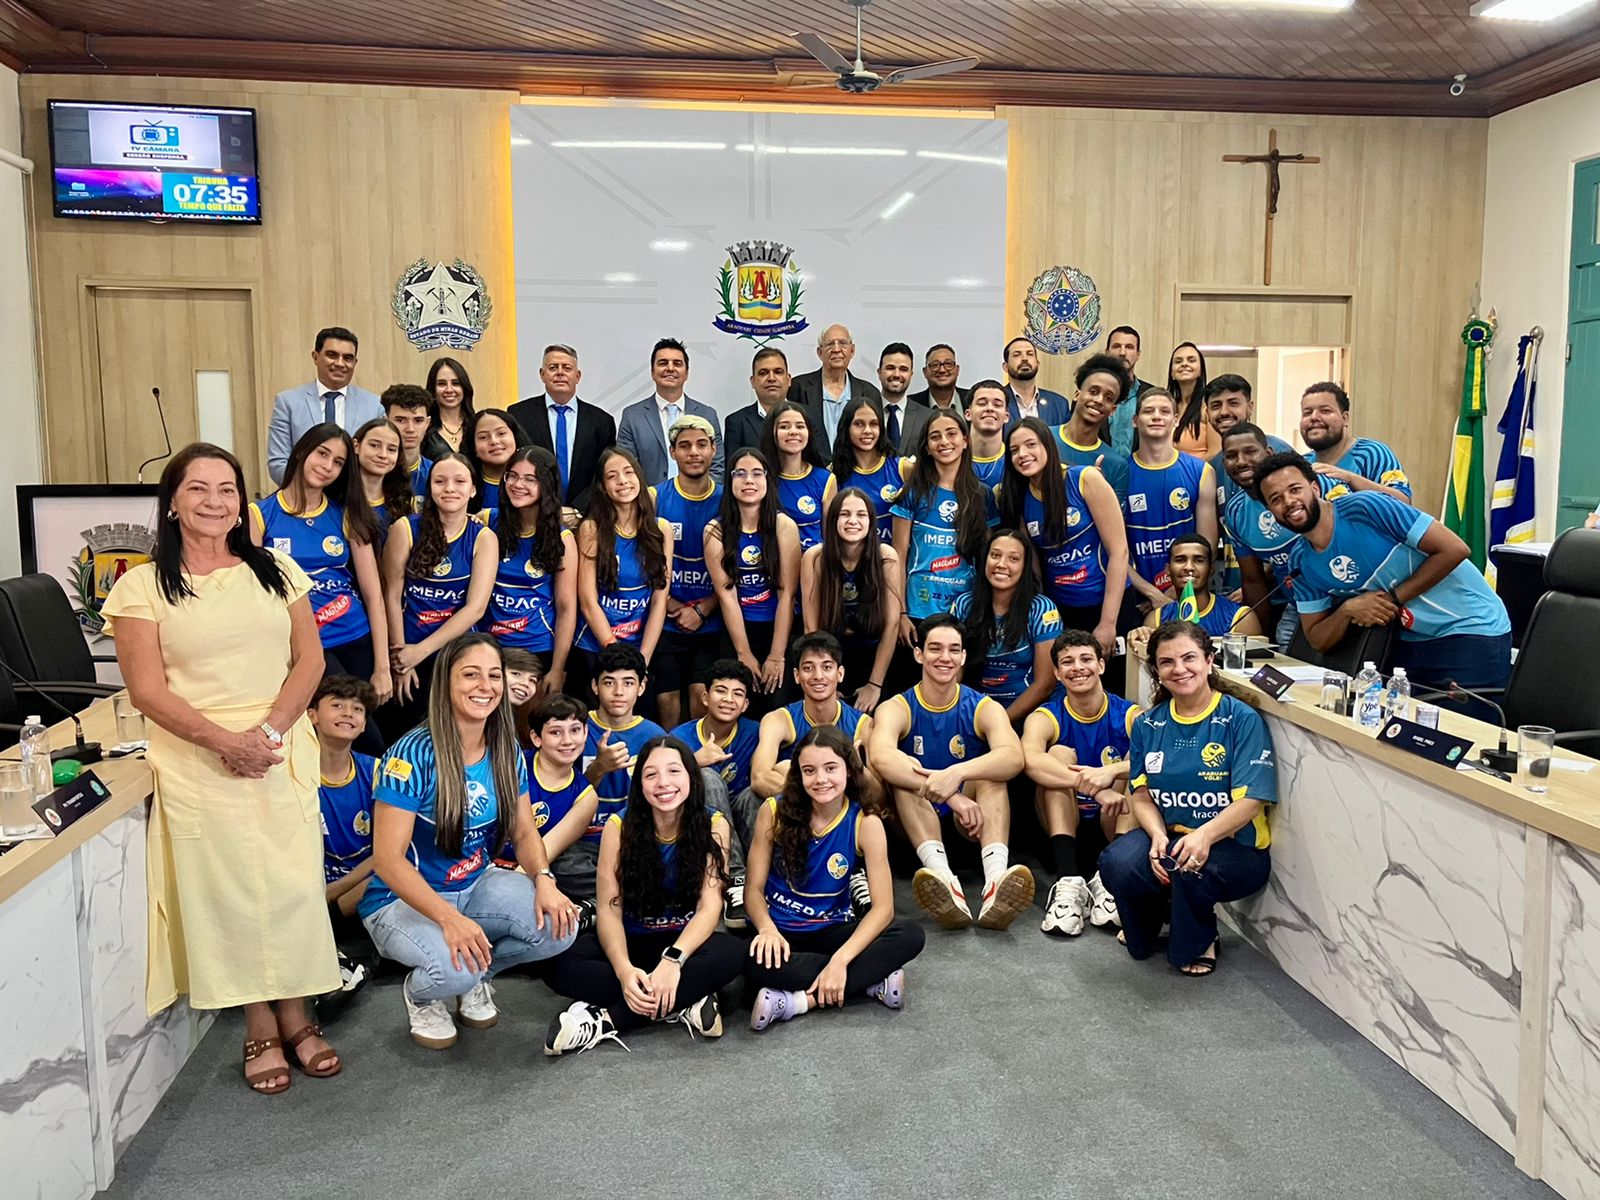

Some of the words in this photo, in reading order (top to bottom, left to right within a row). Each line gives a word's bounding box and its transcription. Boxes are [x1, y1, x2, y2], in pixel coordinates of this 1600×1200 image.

[192, 176, 229, 185] TRIBUNA
[173, 183, 248, 204] 07:35
[178, 202, 206, 210] TEMPO
[206, 203, 222, 211] QUE
[223, 203, 246, 212] FALTA
[409, 328, 431, 339] ESTADO
[458, 329, 479, 339] GERAIS
[924, 533, 956, 546] IMEP
[1135, 538, 1176, 555] IMEP
[932, 557, 960, 570] MAGUARY
[602, 595, 650, 611] IMEPA
[1160, 792, 1231, 808] SICOOB
[1192, 809, 1219, 819] Araco
